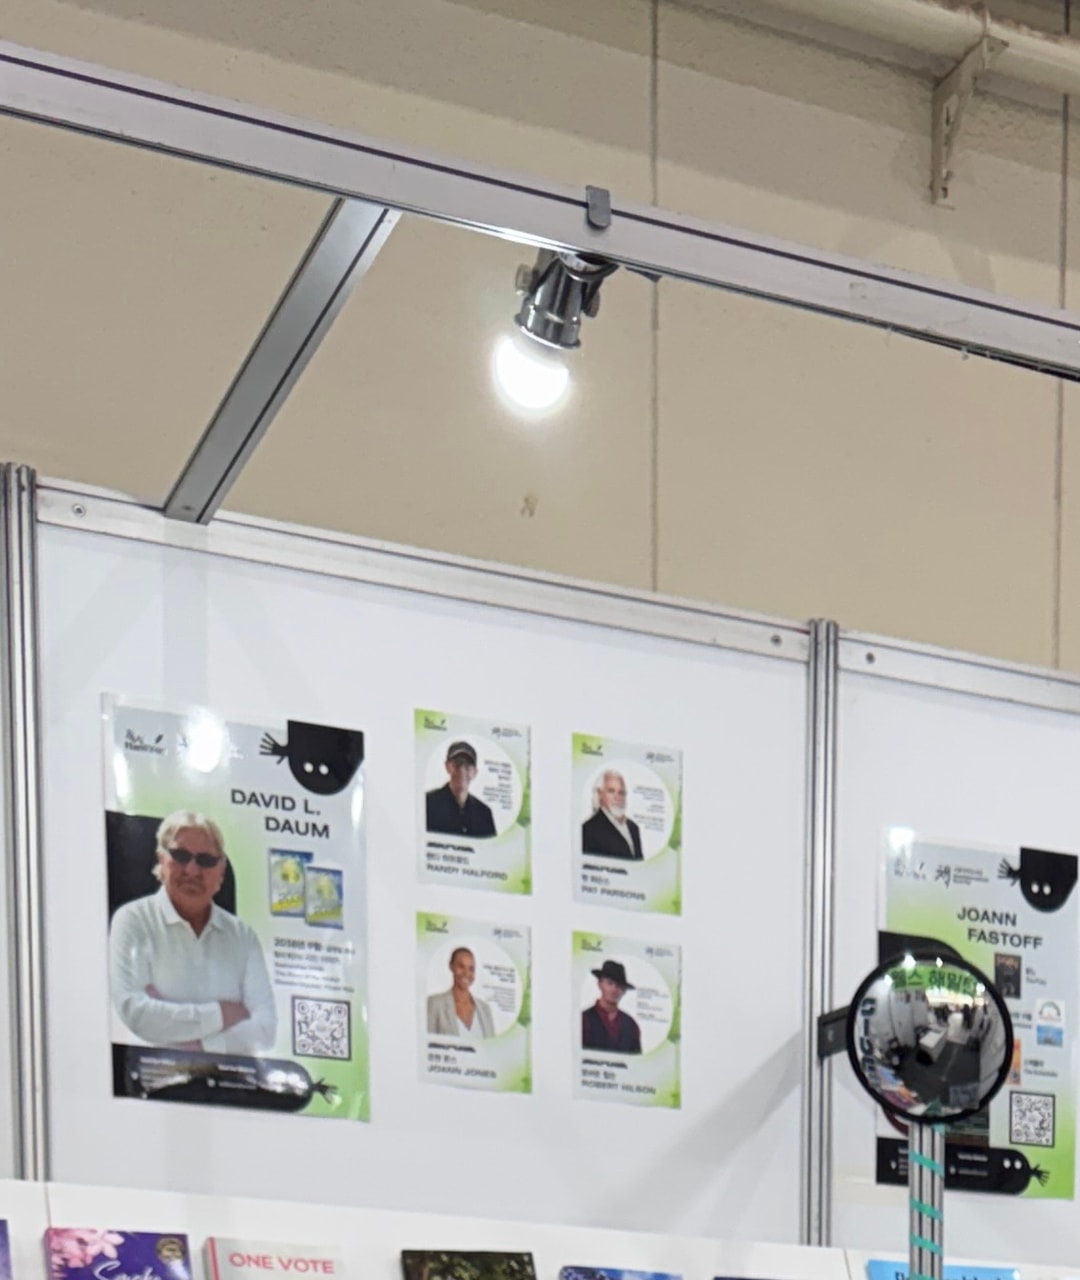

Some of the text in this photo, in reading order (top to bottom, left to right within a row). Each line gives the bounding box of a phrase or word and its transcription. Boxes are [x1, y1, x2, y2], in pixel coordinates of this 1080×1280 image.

[231, 788, 321, 815] DAVID L.
[265, 816, 330, 839] DAUM
[957, 906, 1017, 927] JOANN
[967, 928, 1043, 950] FASTOFF
[229, 1252, 335, 1275] ONE VOTE
